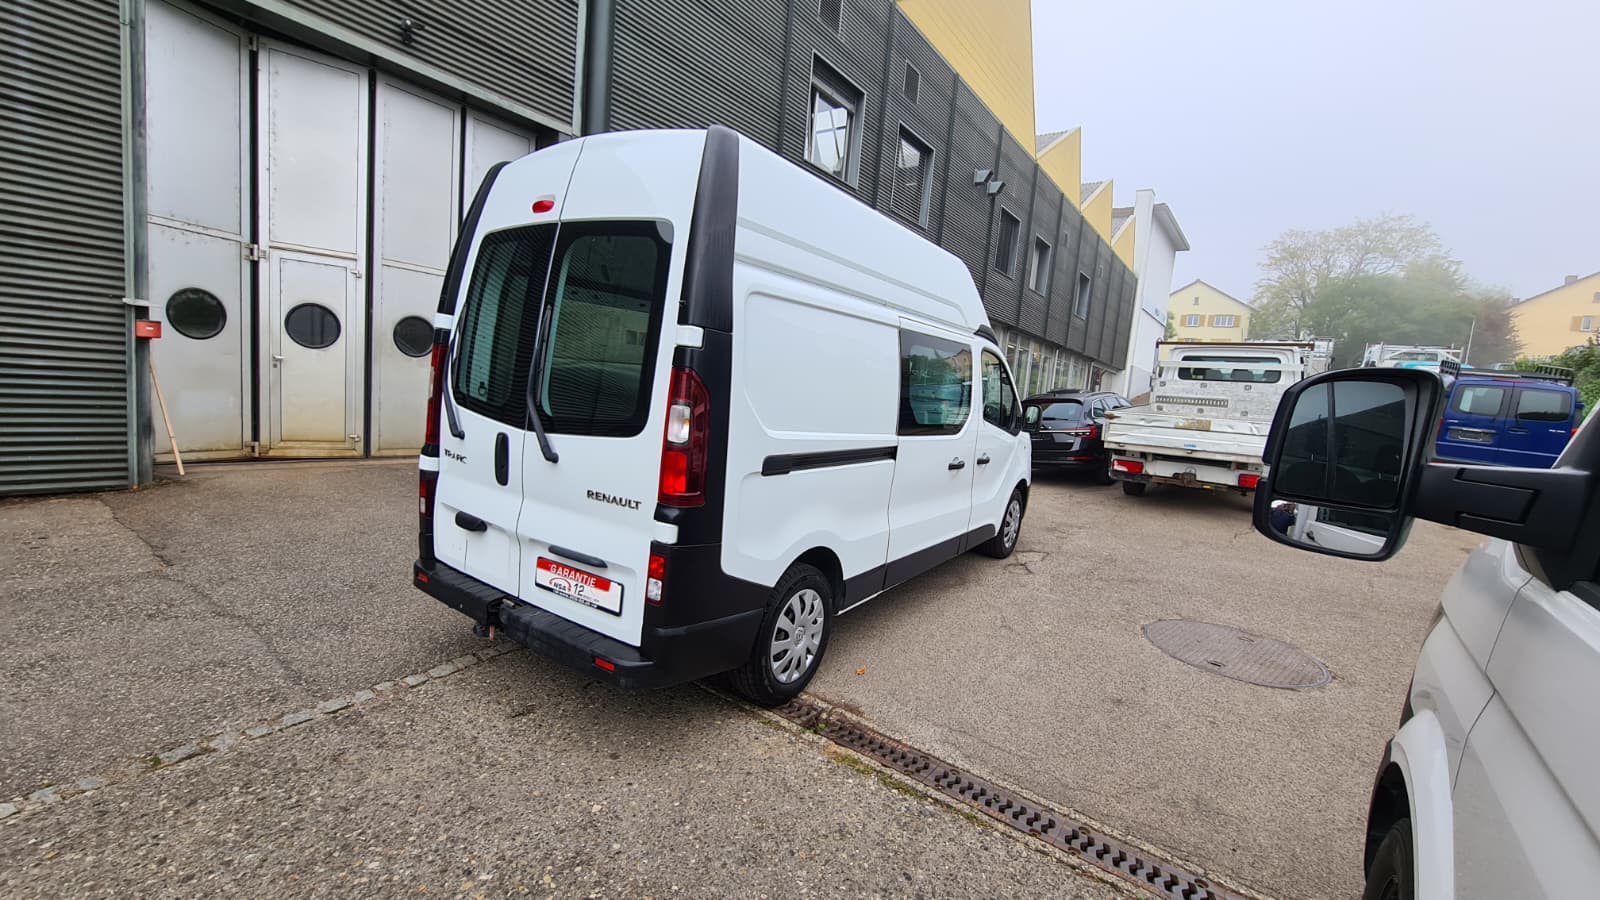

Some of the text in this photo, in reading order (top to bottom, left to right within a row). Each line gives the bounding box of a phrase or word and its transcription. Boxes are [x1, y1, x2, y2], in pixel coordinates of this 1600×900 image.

[586, 489, 642, 510] RENAULT
[550, 565, 596, 587] GARANTIE
[573, 583, 585, 596] 12
